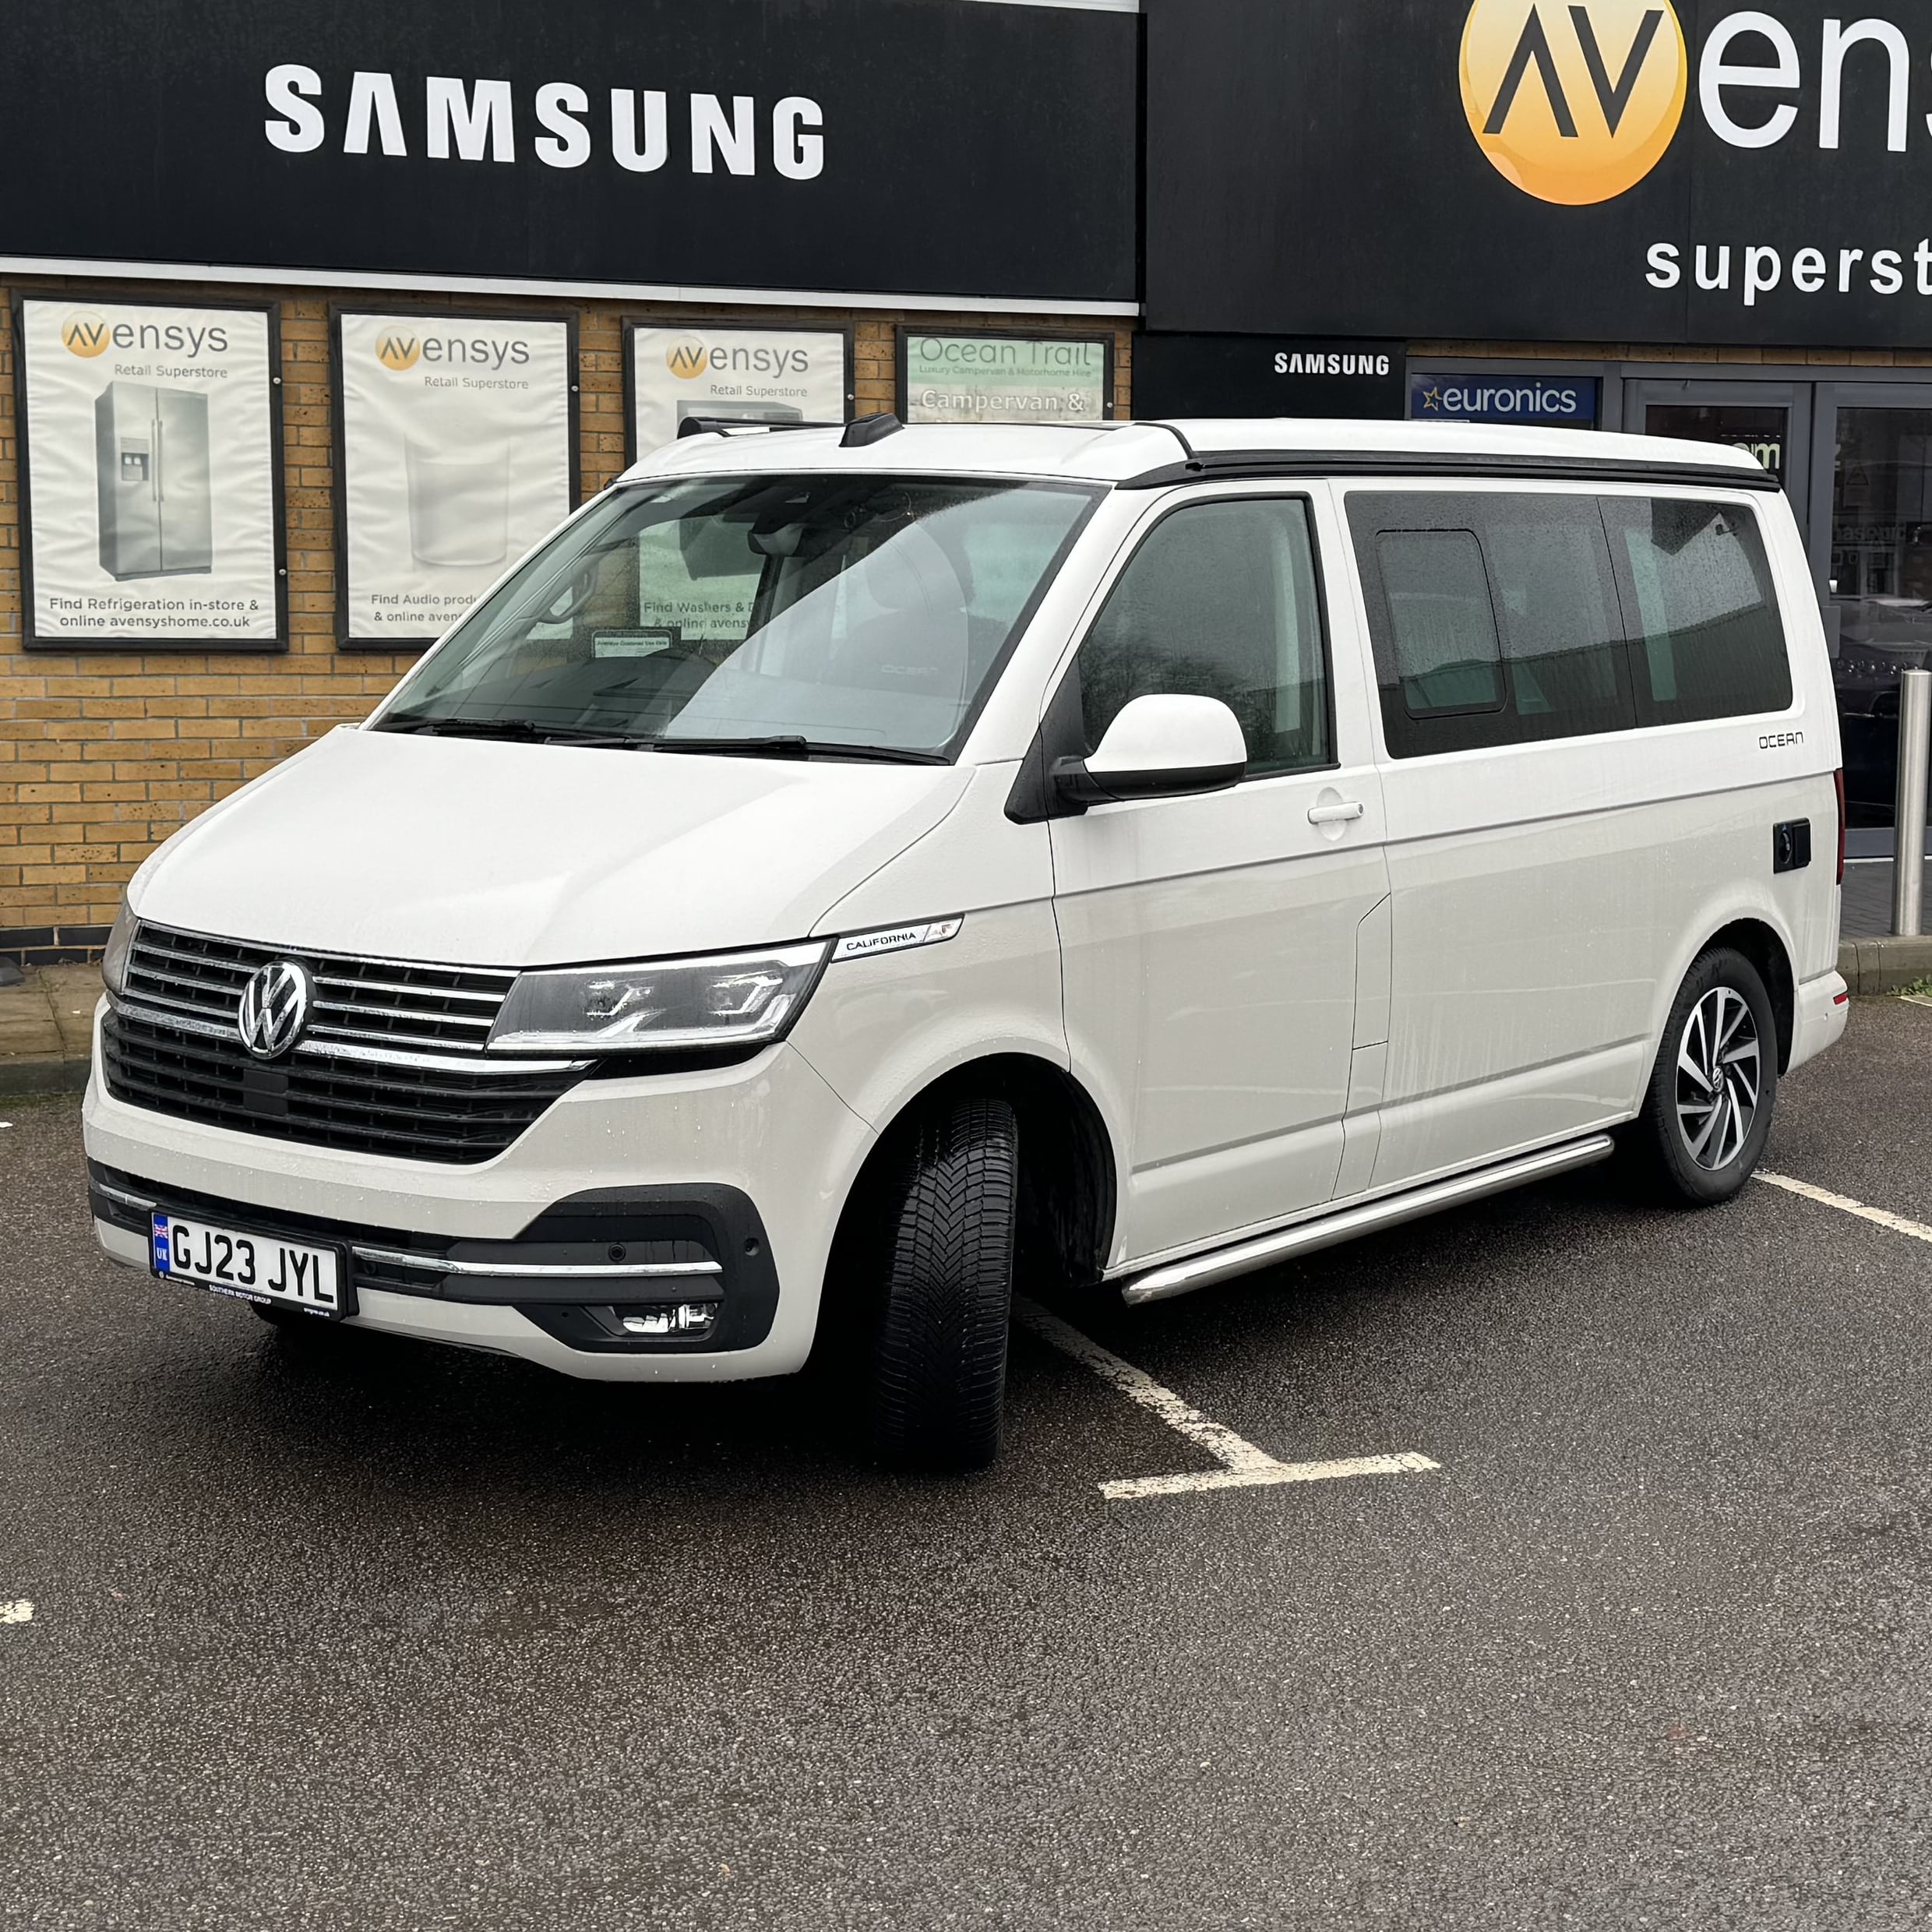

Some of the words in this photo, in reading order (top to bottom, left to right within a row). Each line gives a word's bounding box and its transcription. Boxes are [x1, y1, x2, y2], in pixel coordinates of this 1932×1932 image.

[264, 63, 824, 181] SAMSUNG
[1645, 238, 1932, 307] superst
[920, 337, 1016, 365] Ocean
[1026, 340, 1091, 366] Trail
[115, 364, 151, 375] Retail
[157, 365, 227, 378] Superstore
[919, 365, 950, 375] Luxury
[952, 366, 1006, 376] Campervan
[1016, 368, 1070, 377] Motorhome
[1072, 369, 1091, 378] Hire
[1274, 352, 1390, 376] SAMSUNG
[425, 375, 459, 388] Retail
[463, 377, 529, 390] Superstore
[710, 384, 742, 396] Retail
[746, 386, 808, 398] Superstore
[1443, 382, 1578, 414] euronics
[921, 389, 1058, 413] Campervan
[1067, 393, 1085, 411] &
[49, 598, 83, 610] Find
[88, 598, 185, 612] Refrigeration
[189, 599, 245, 610] in-store
[249, 600, 259, 610] &
[371, 594, 399, 605] Find
[403, 594, 440, 605] Audio
[644, 601, 672, 612] Find
[677, 602, 731, 612] Washers
[735, 602, 744, 612] &
[60, 615, 105, 626] online
[110, 615, 250, 629] avensyshome.co.uk
[374, 612, 383, 621] &
[387, 612, 425, 621] online
[1758, 731, 1804, 749] OCEAN
[846, 932, 916, 950] CALIFORNIA
[157, 1247, 167, 1261] UK
[172, 1225, 256, 1285] GJ23
[268, 1247, 334, 1303] JYL
